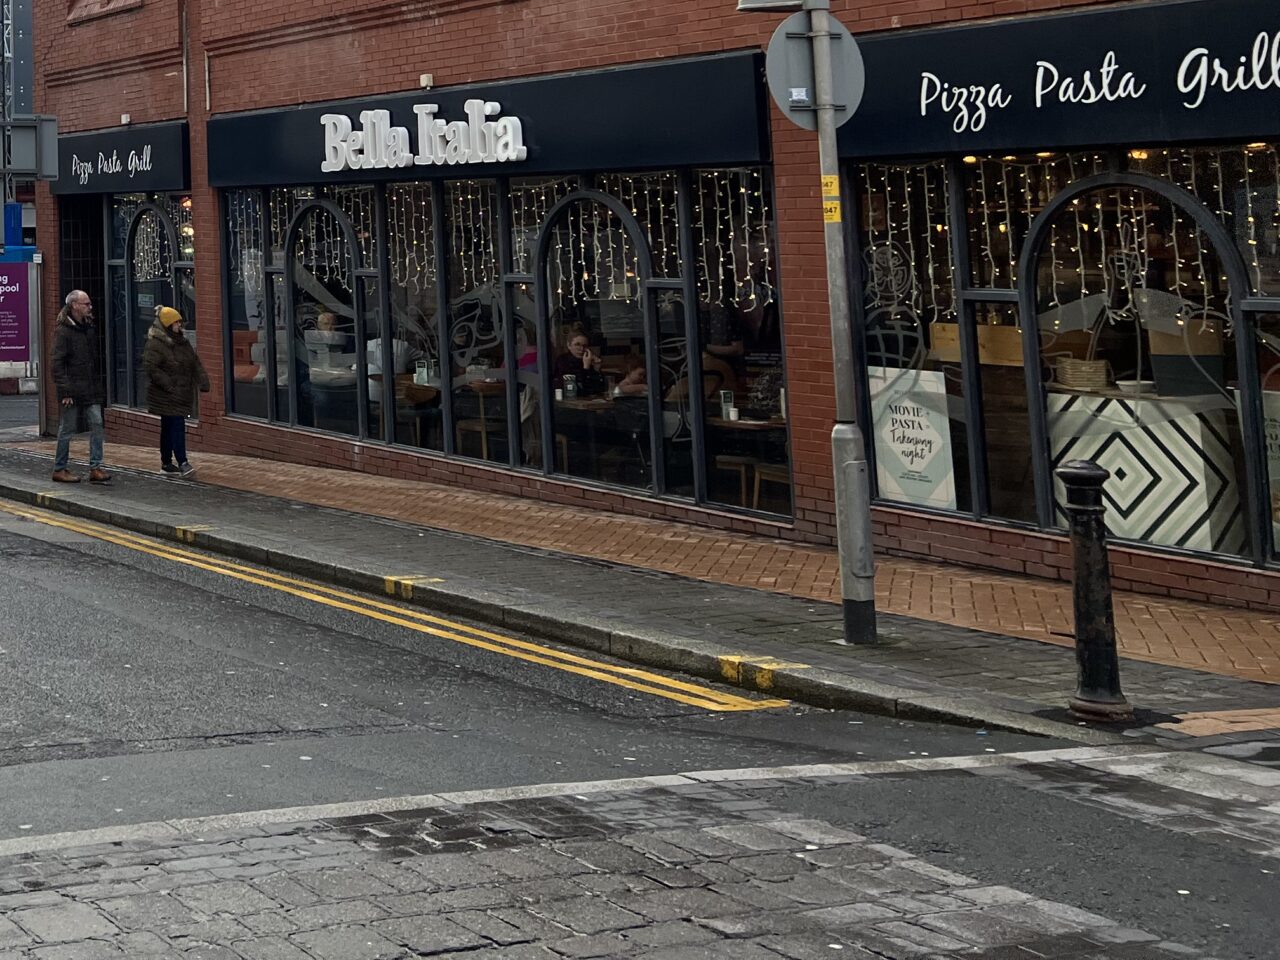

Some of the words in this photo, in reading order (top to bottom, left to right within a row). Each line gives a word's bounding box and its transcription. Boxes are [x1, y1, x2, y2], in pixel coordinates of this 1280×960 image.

[920, 72, 1012, 133] Pizza
[1035, 50, 1147, 108] Pasta
[320, 108, 413, 172] Bella
[413, 99, 527, 165] Italia
[72, 154, 94, 185] Pizza
[98, 149, 123, 174] Pasta
[128, 144, 152, 178] Grill
[888, 404, 923, 418] MOVIE
[891, 417, 923, 431] PASTA
[890, 427, 934, 454] Takeaway
[901, 447, 927, 466] night
